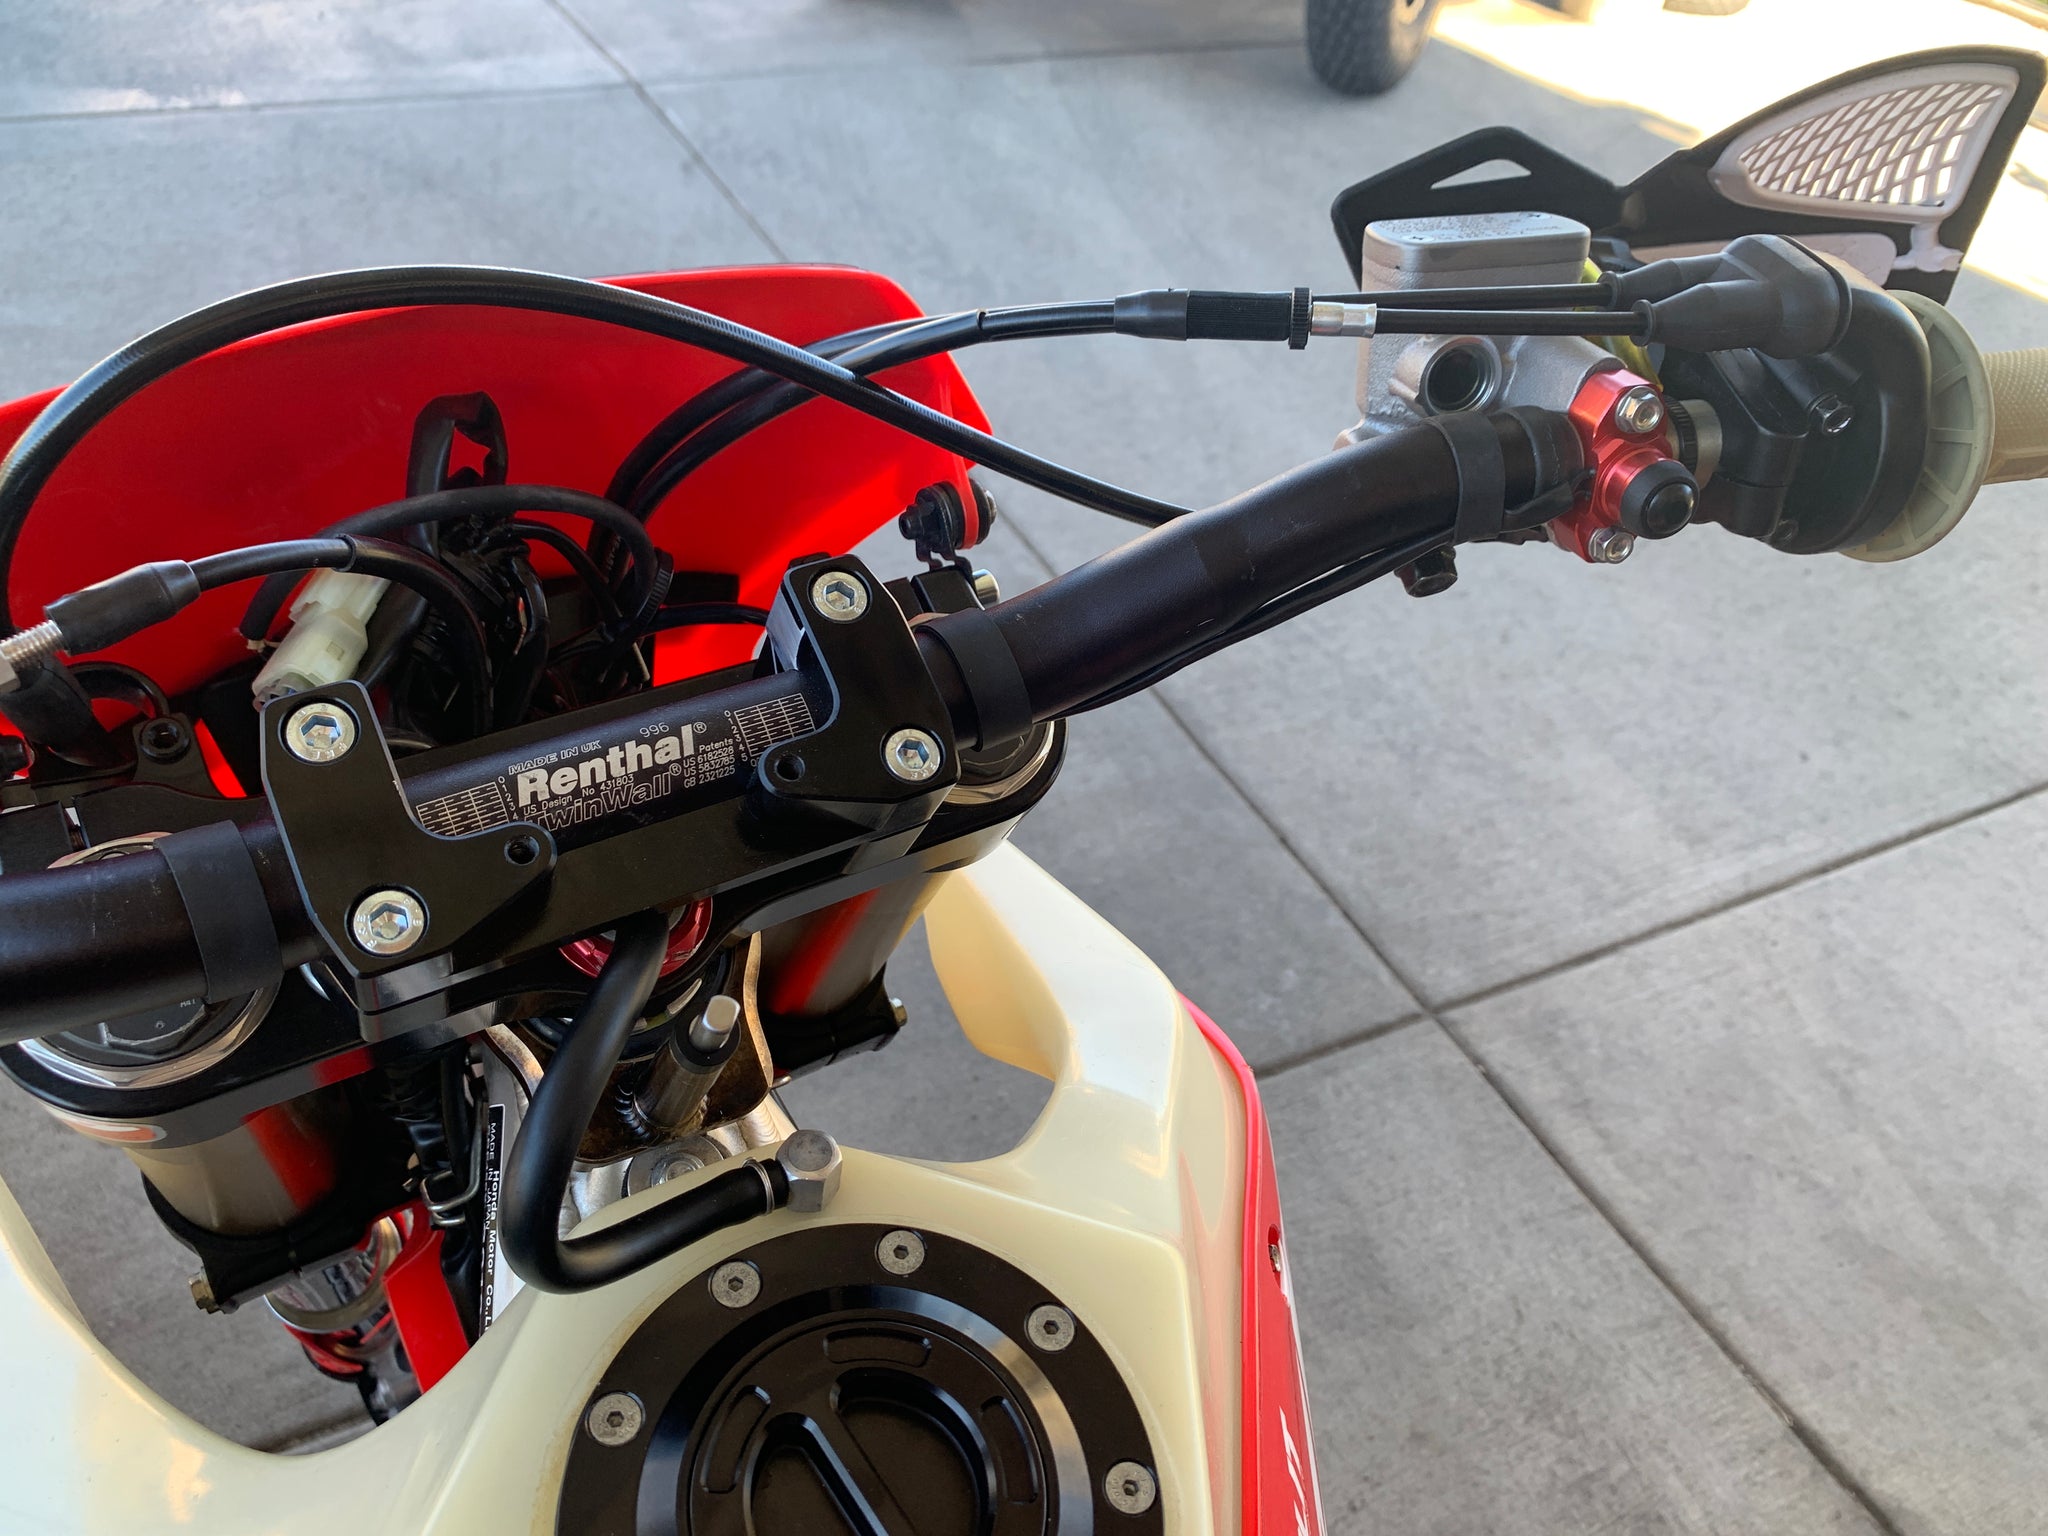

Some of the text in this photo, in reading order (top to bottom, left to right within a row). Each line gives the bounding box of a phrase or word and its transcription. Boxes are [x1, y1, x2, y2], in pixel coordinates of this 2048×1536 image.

[639, 721, 670, 738] 996
[508, 739, 602, 775] MADE IN UK
[683, 745, 735, 768] US 6182528
[698, 737, 734, 754] Patents
[683, 754, 736, 777] US 5832785
[683, 766, 736, 789] GB 2321225
[523, 773, 634, 816] US Design No 431803
[489, 1122, 497, 1160] MADE
[488, 1167, 494, 1180] IN
[484, 1190, 494, 1230] JAPAN
[491, 1171, 500, 1220] Honda
[487, 1229, 496, 1275] Motor
